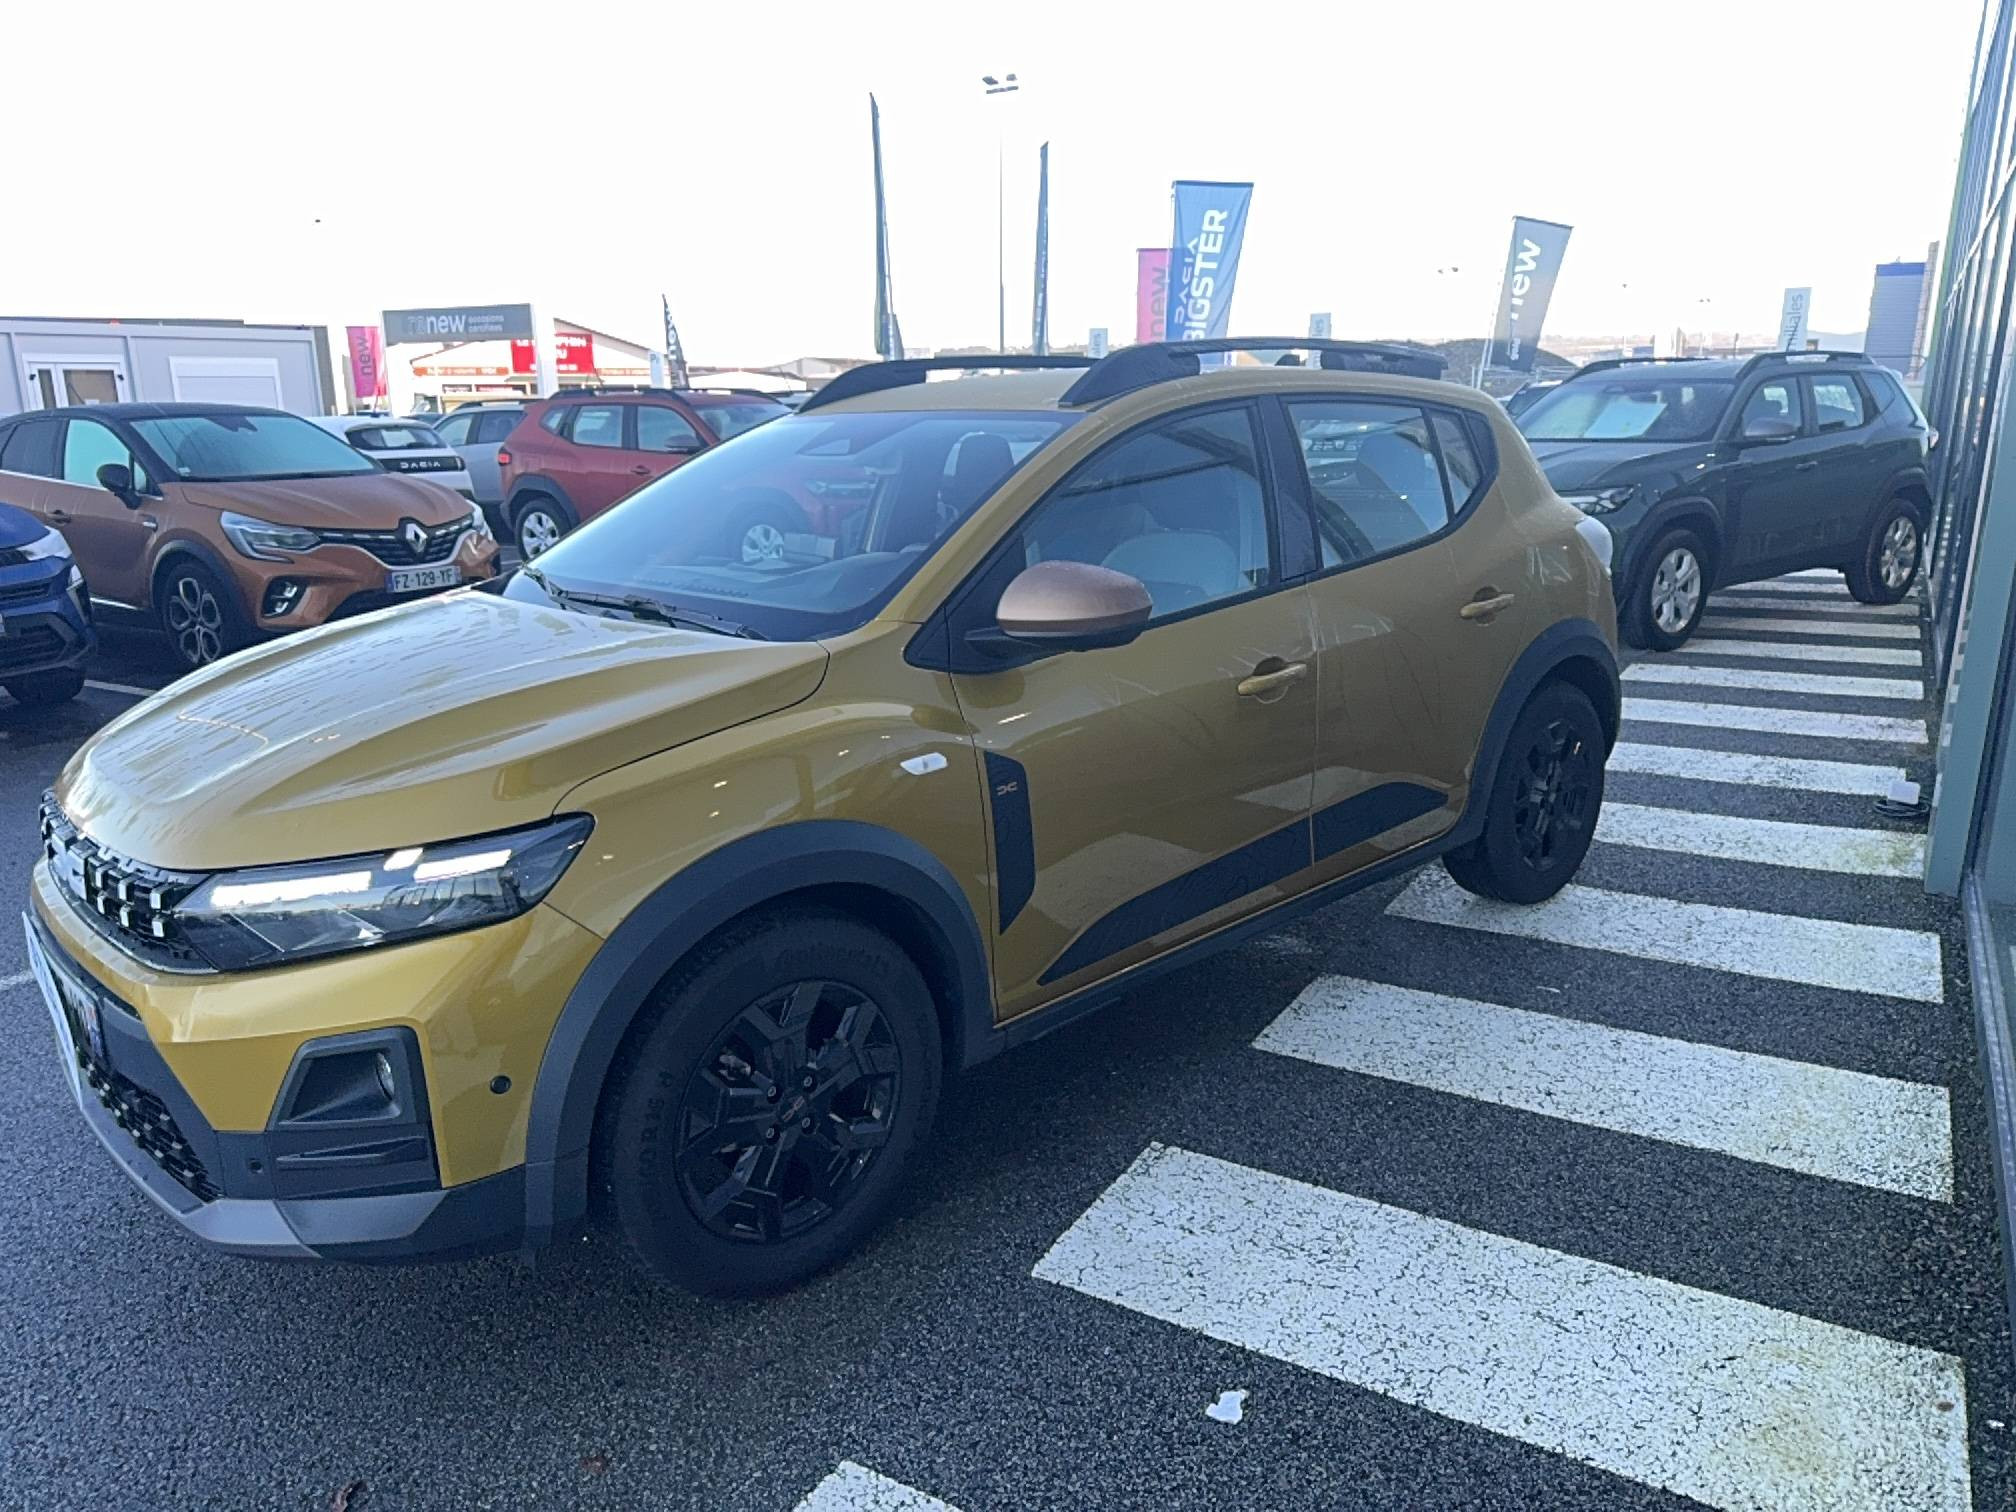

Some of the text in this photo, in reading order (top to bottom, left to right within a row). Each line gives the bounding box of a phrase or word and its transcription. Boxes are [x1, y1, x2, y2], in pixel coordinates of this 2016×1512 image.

[1174, 238, 1199, 324] DACIA
[1182, 209, 1229, 341] BIGSTER
[400, 461, 441, 470] DACIA
